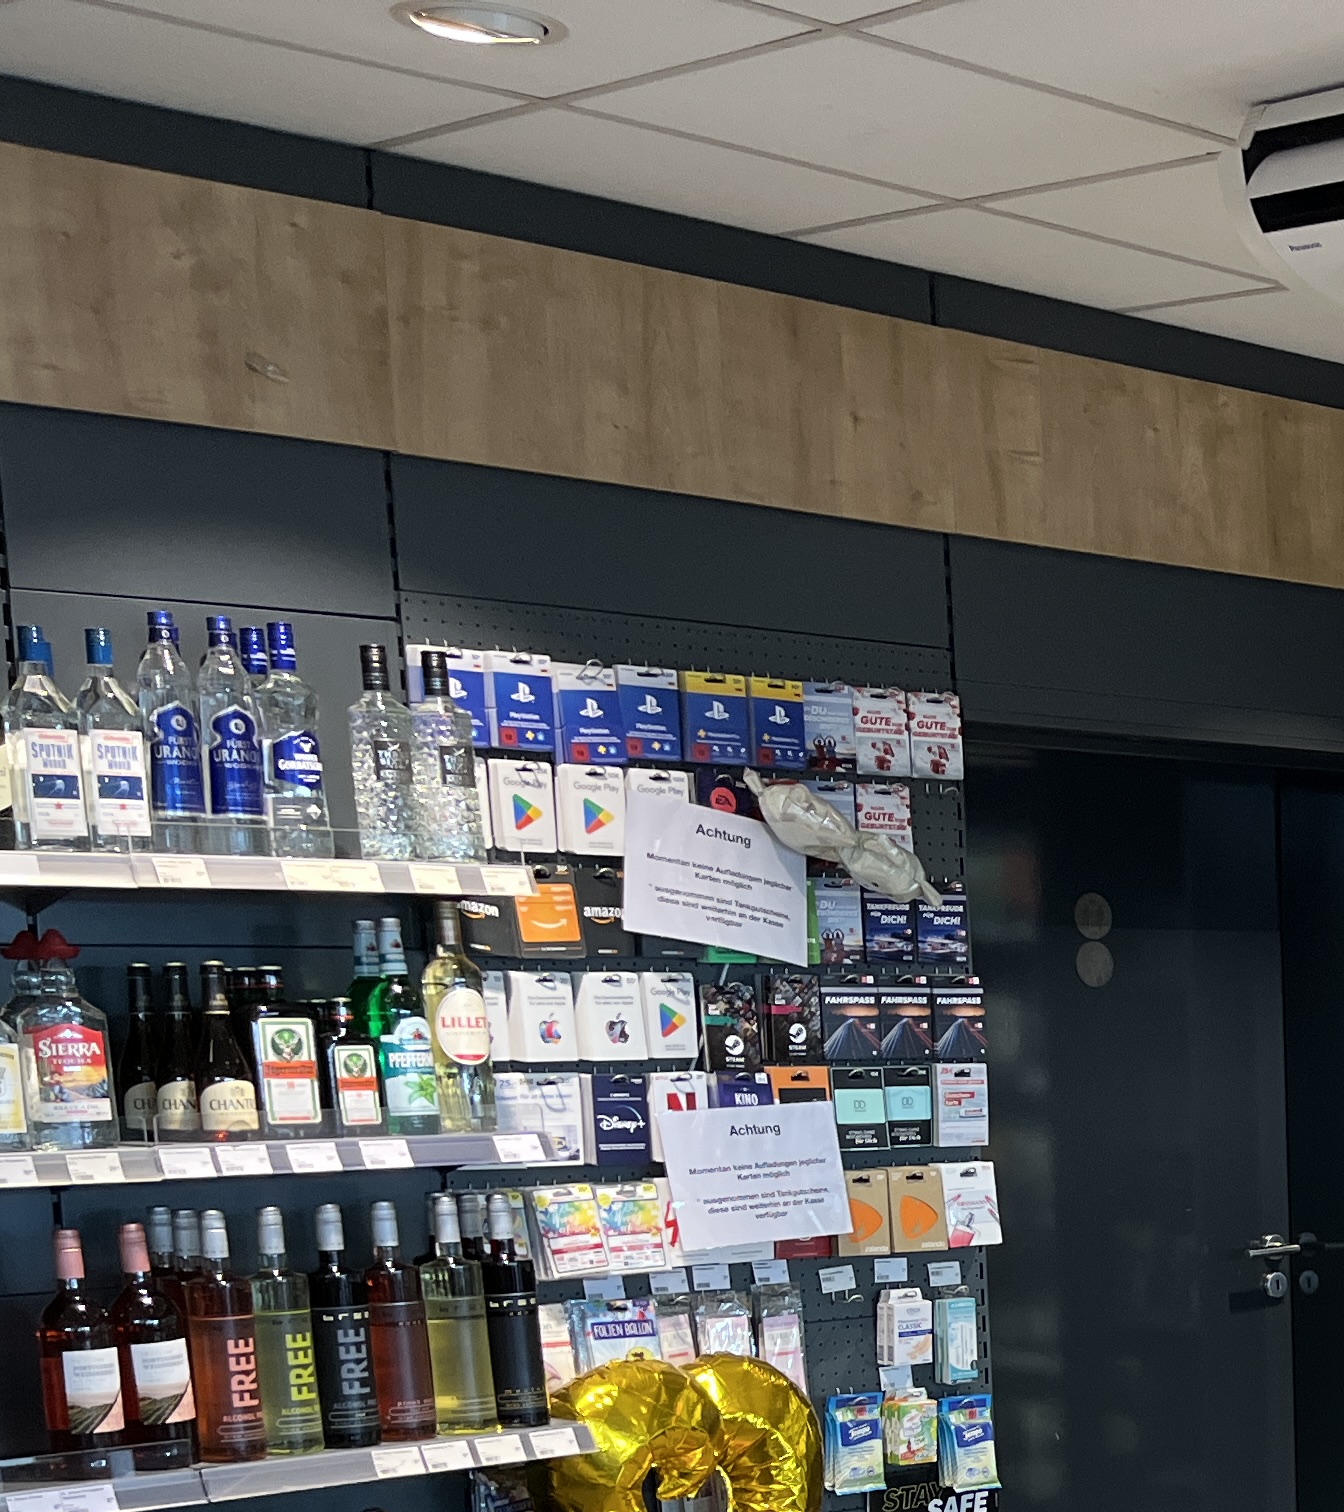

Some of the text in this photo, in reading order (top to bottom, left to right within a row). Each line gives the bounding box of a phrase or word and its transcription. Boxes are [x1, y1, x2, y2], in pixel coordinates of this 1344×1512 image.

[860, 716, 891, 726] GUTE
[917, 720, 946, 731] GUTE
[97, 743, 138, 761] SPUTNIK
[214, 749, 260, 762] URANO
[574, 781, 602, 793] Google
[637, 784, 666, 796] Google
[696, 824, 752, 848] Achtung
[584, 907, 623, 918] amazo
[825, 996, 875, 1005] FAHRSPASS
[881, 996, 927, 1005] FAHRSPASS
[441, 1016, 487, 1028] LILLET
[38, 1039, 101, 1057] SIERRA
[735, 1093, 758, 1106] KINO
[729, 1124, 781, 1136] Achtung
[593, 1320, 653, 1338] FOLIEN BALLON
[285, 1332, 316, 1401] FREE
[337, 1327, 371, 1395] FREE
[227, 1337, 260, 1408] FREE
[883, 1483, 940, 1512] STAY
